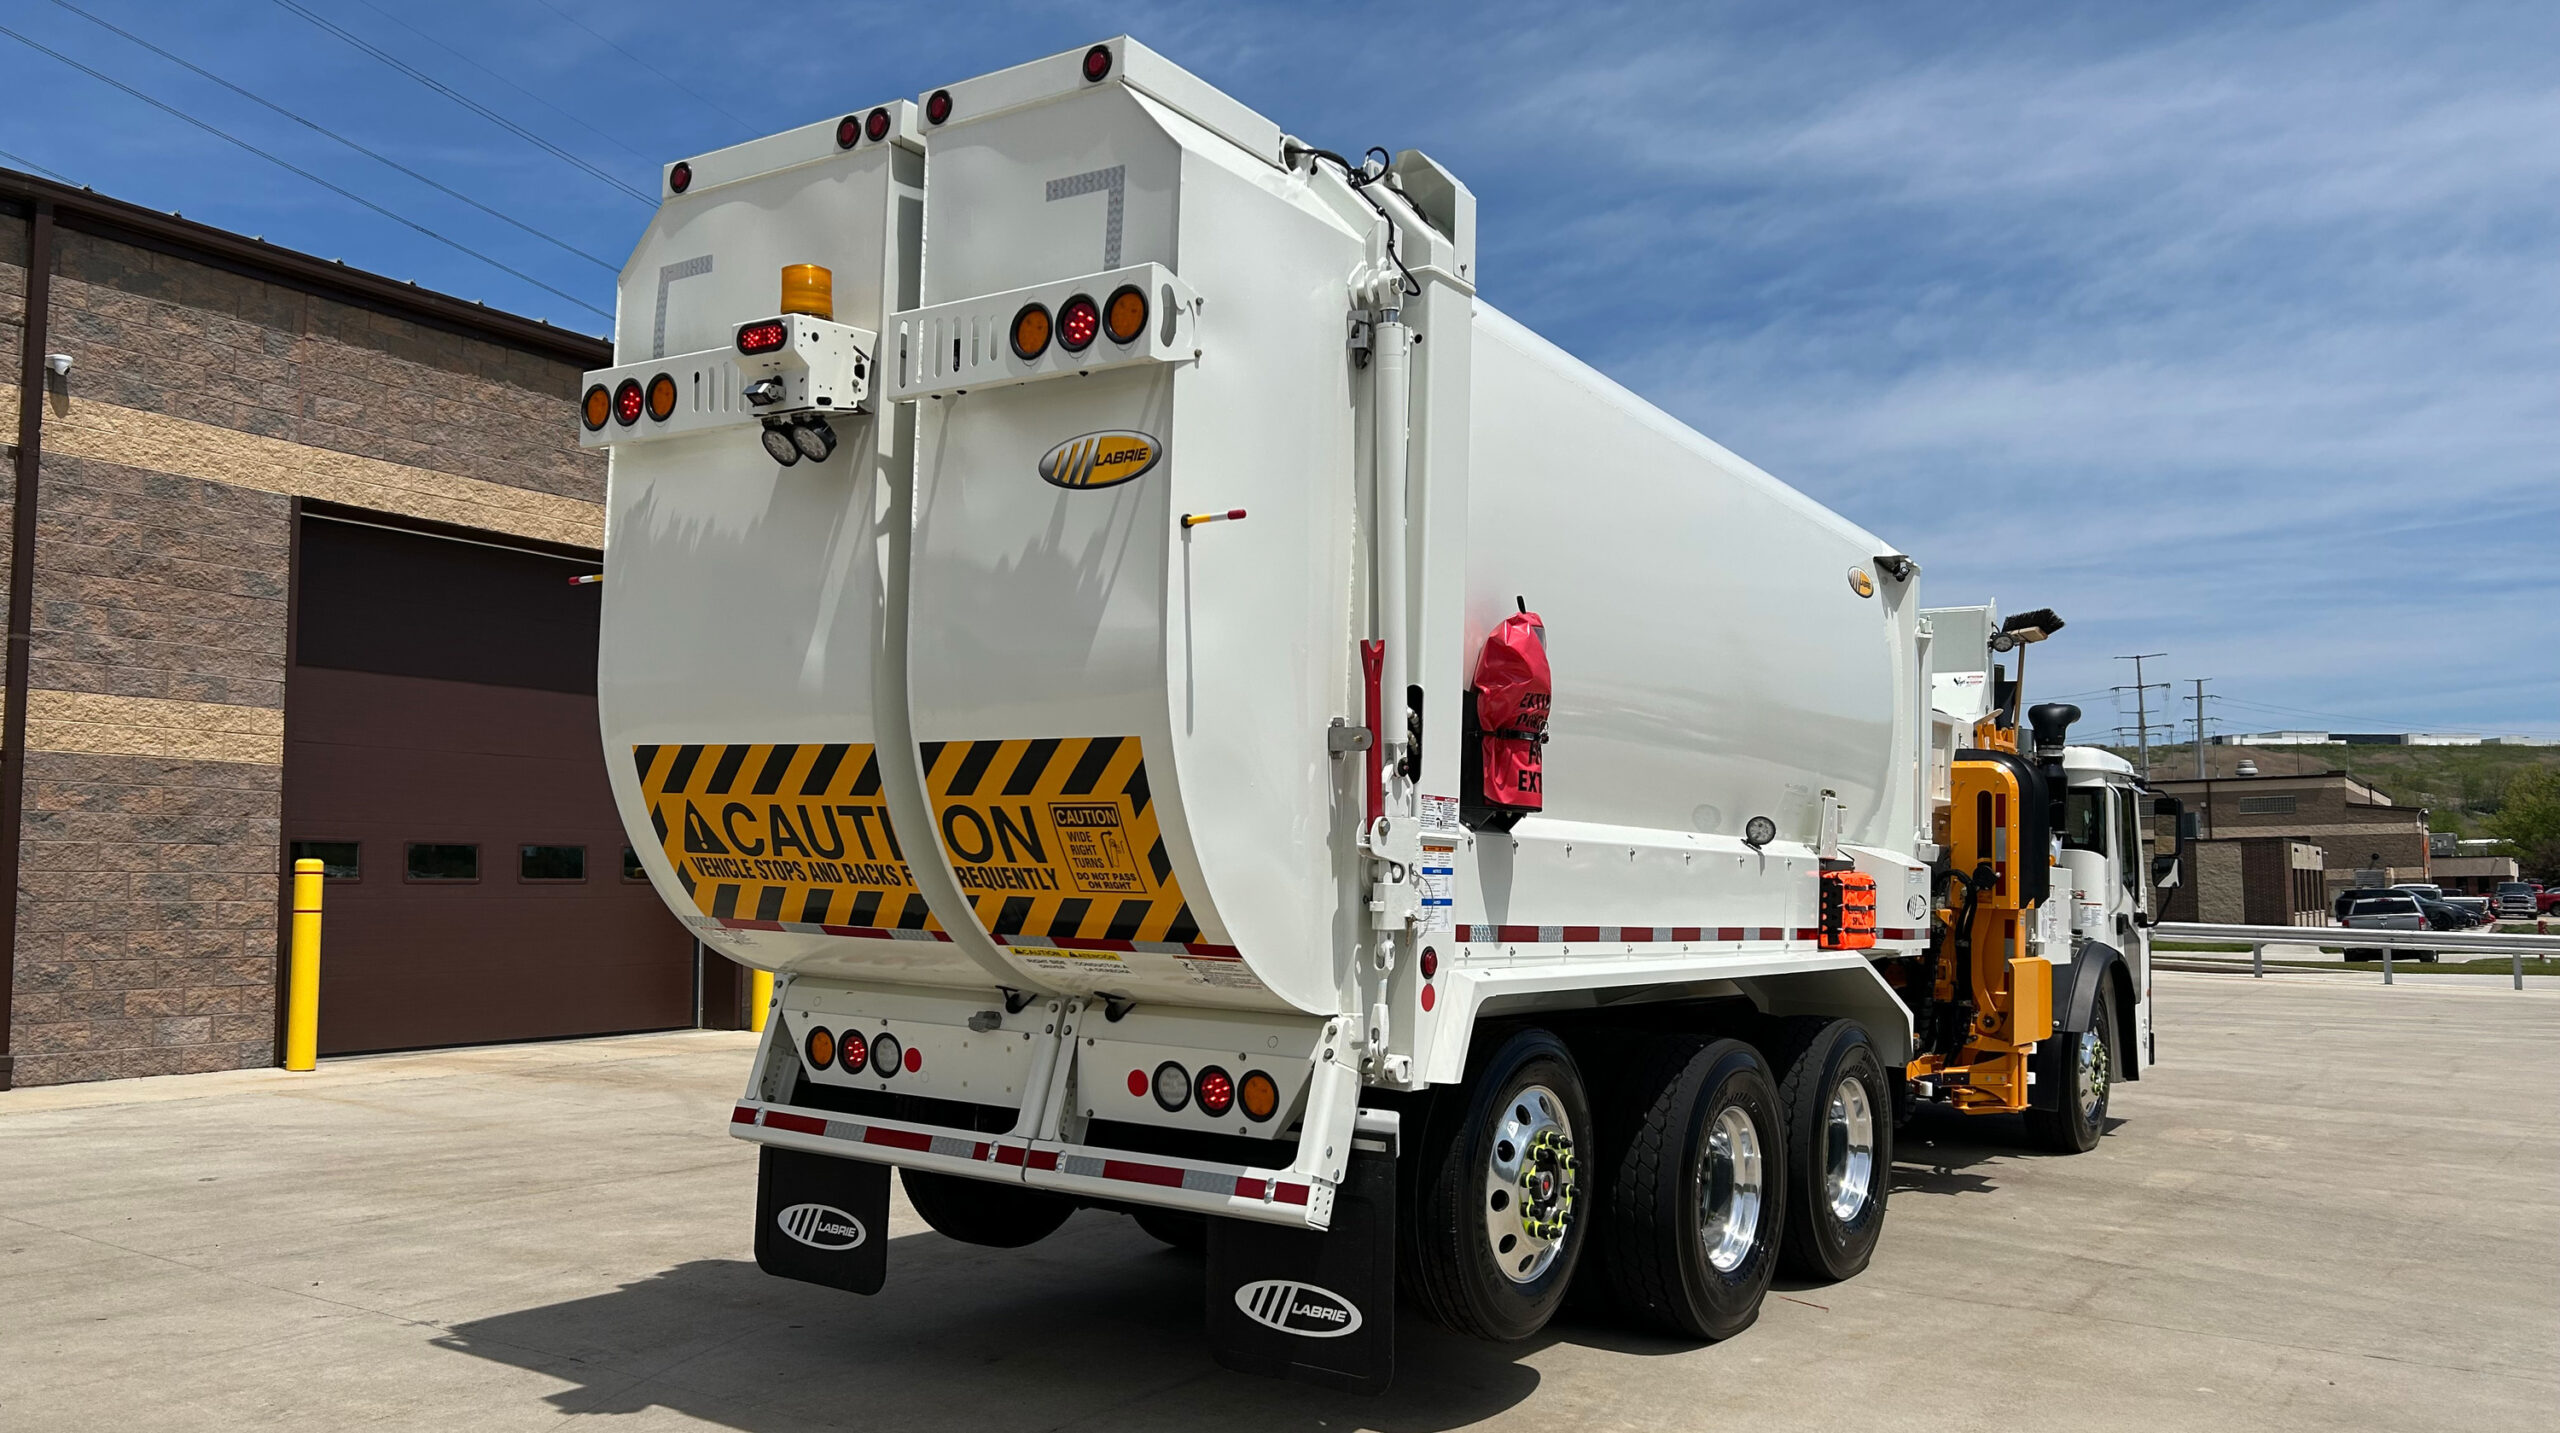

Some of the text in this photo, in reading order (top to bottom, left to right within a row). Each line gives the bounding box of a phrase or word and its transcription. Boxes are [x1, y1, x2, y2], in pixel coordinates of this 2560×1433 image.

[1094, 447, 1149, 467] LABRIE
[1055, 809, 1118, 825] CAUTION
[1066, 831, 1093, 843] WIDE
[1069, 844, 1098, 856] RIGHT
[1071, 857, 1105, 869] TURNS
[690, 856, 756, 880] VEHICLE
[753, 858, 808, 883] STOPS
[809, 861, 844, 884] AND
[842, 863, 902, 887] BACKS
[1076, 872, 1137, 882] DO NOT PASS
[1088, 881, 1132, 890] ON RIGHT
[817, 1221, 857, 1238] LABRIE
[1291, 1301, 1348, 1323] LABRIE
